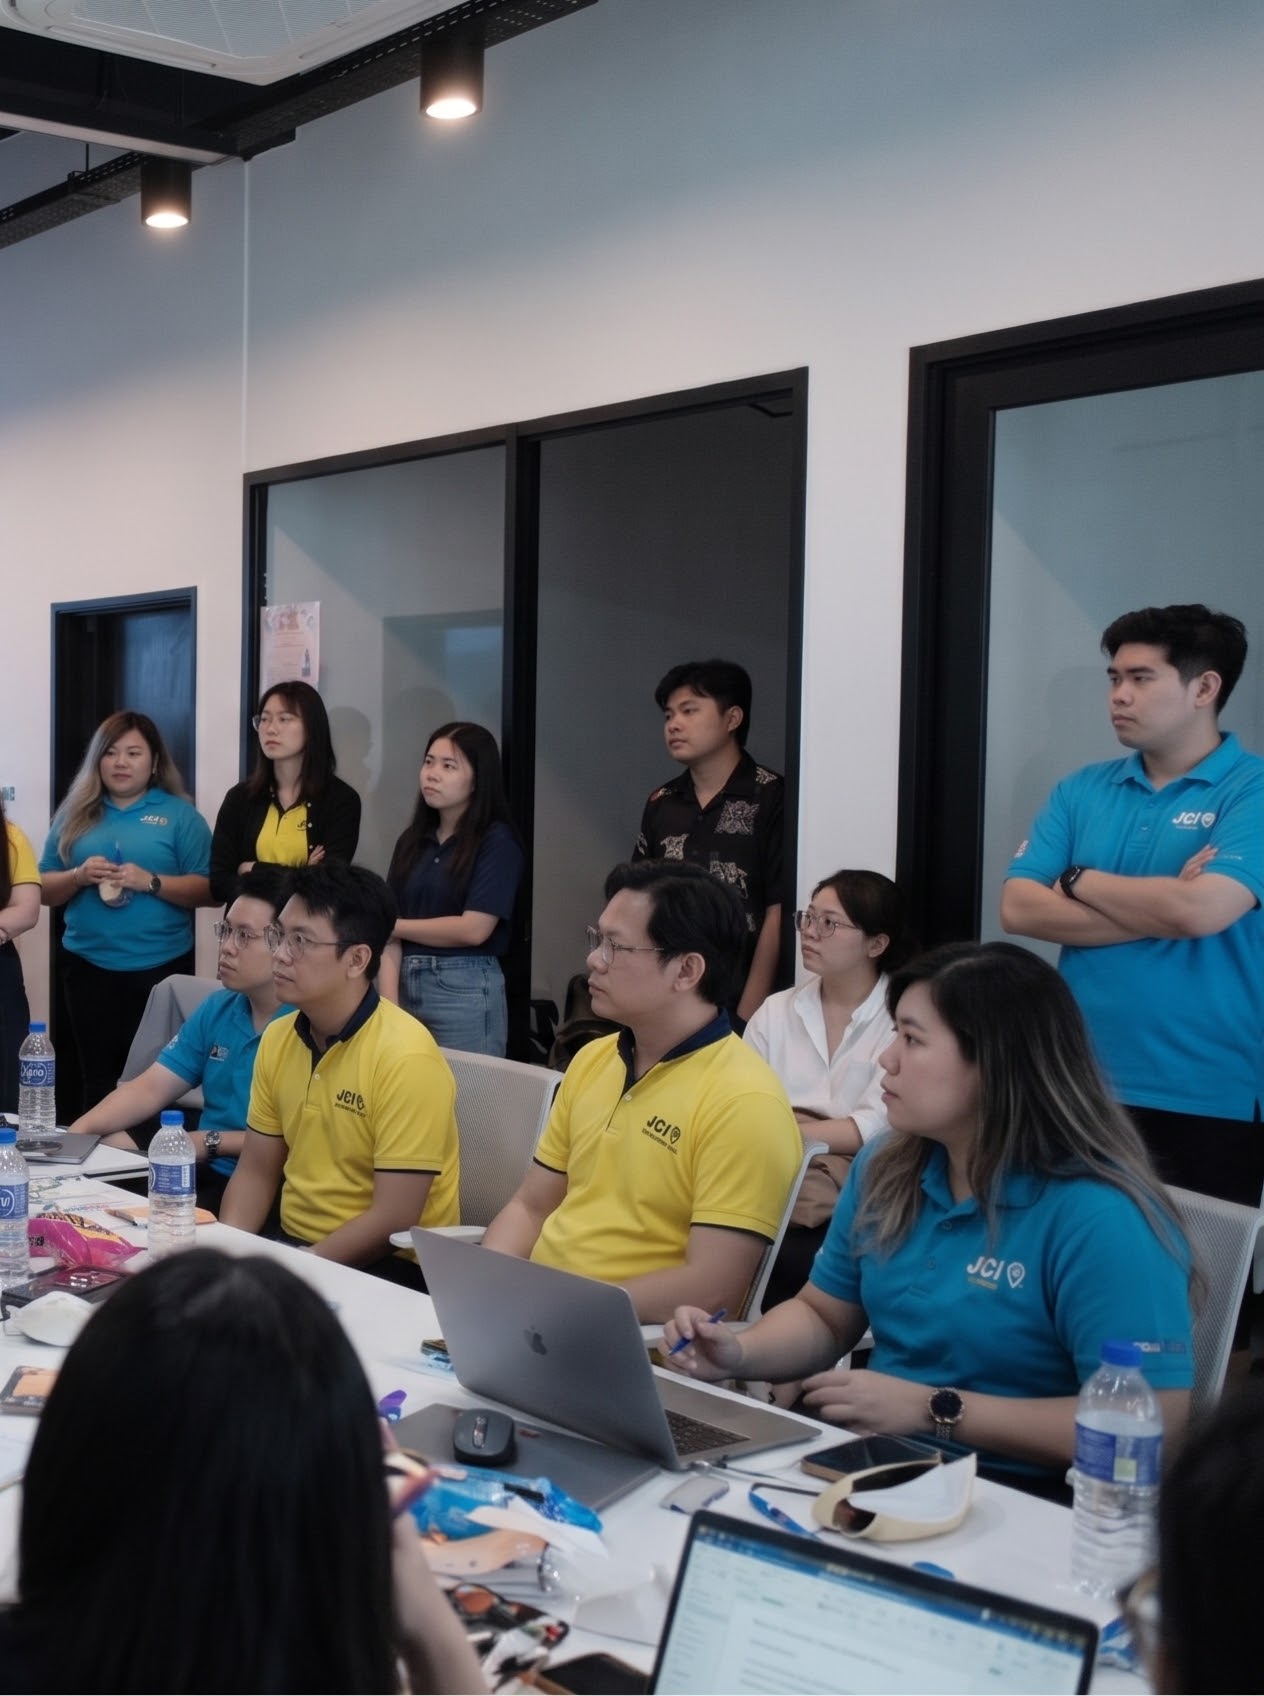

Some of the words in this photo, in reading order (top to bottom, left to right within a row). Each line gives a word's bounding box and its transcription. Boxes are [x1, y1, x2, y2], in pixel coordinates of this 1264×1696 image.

[1172, 811, 1201, 824] JCI
[647, 1115, 672, 1137] JCI
[967, 1256, 1005, 1280] JCI
